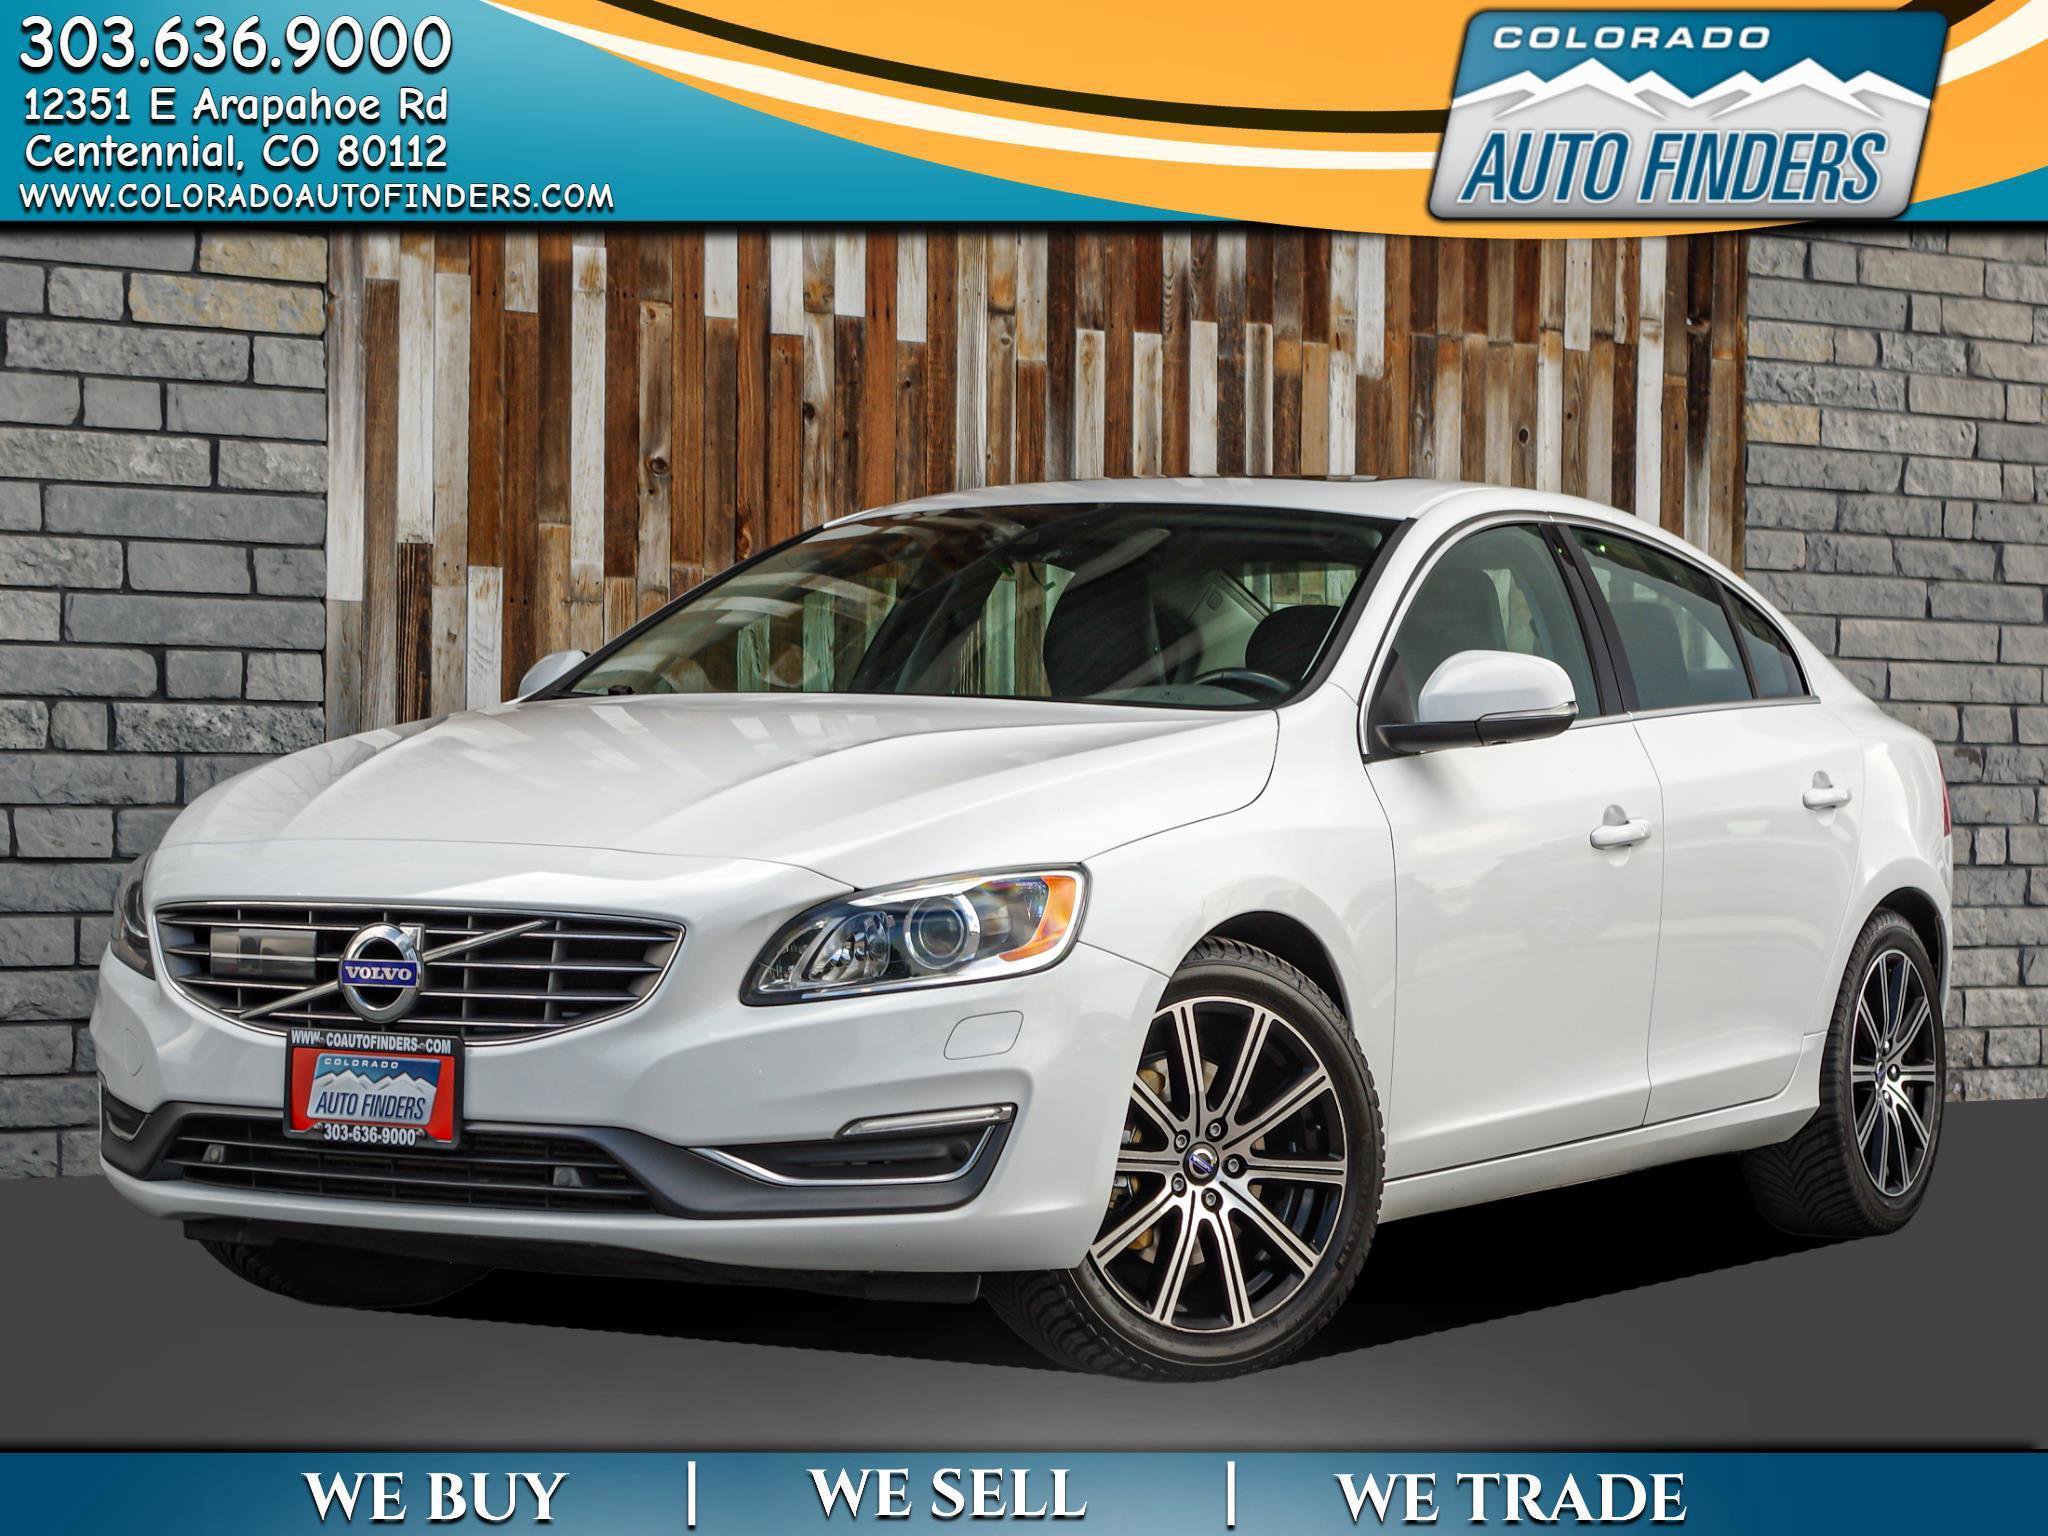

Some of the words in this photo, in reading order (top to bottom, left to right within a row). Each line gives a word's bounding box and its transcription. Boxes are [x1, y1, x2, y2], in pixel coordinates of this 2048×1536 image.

[345, 965, 412, 981] VOLVO
[324, 1057, 399, 1069] COLORADO
[315, 1091, 359, 1116] AUTO
[360, 1093, 426, 1120] FINDERS
[323, 1123, 417, 1146] 303-636-9000
